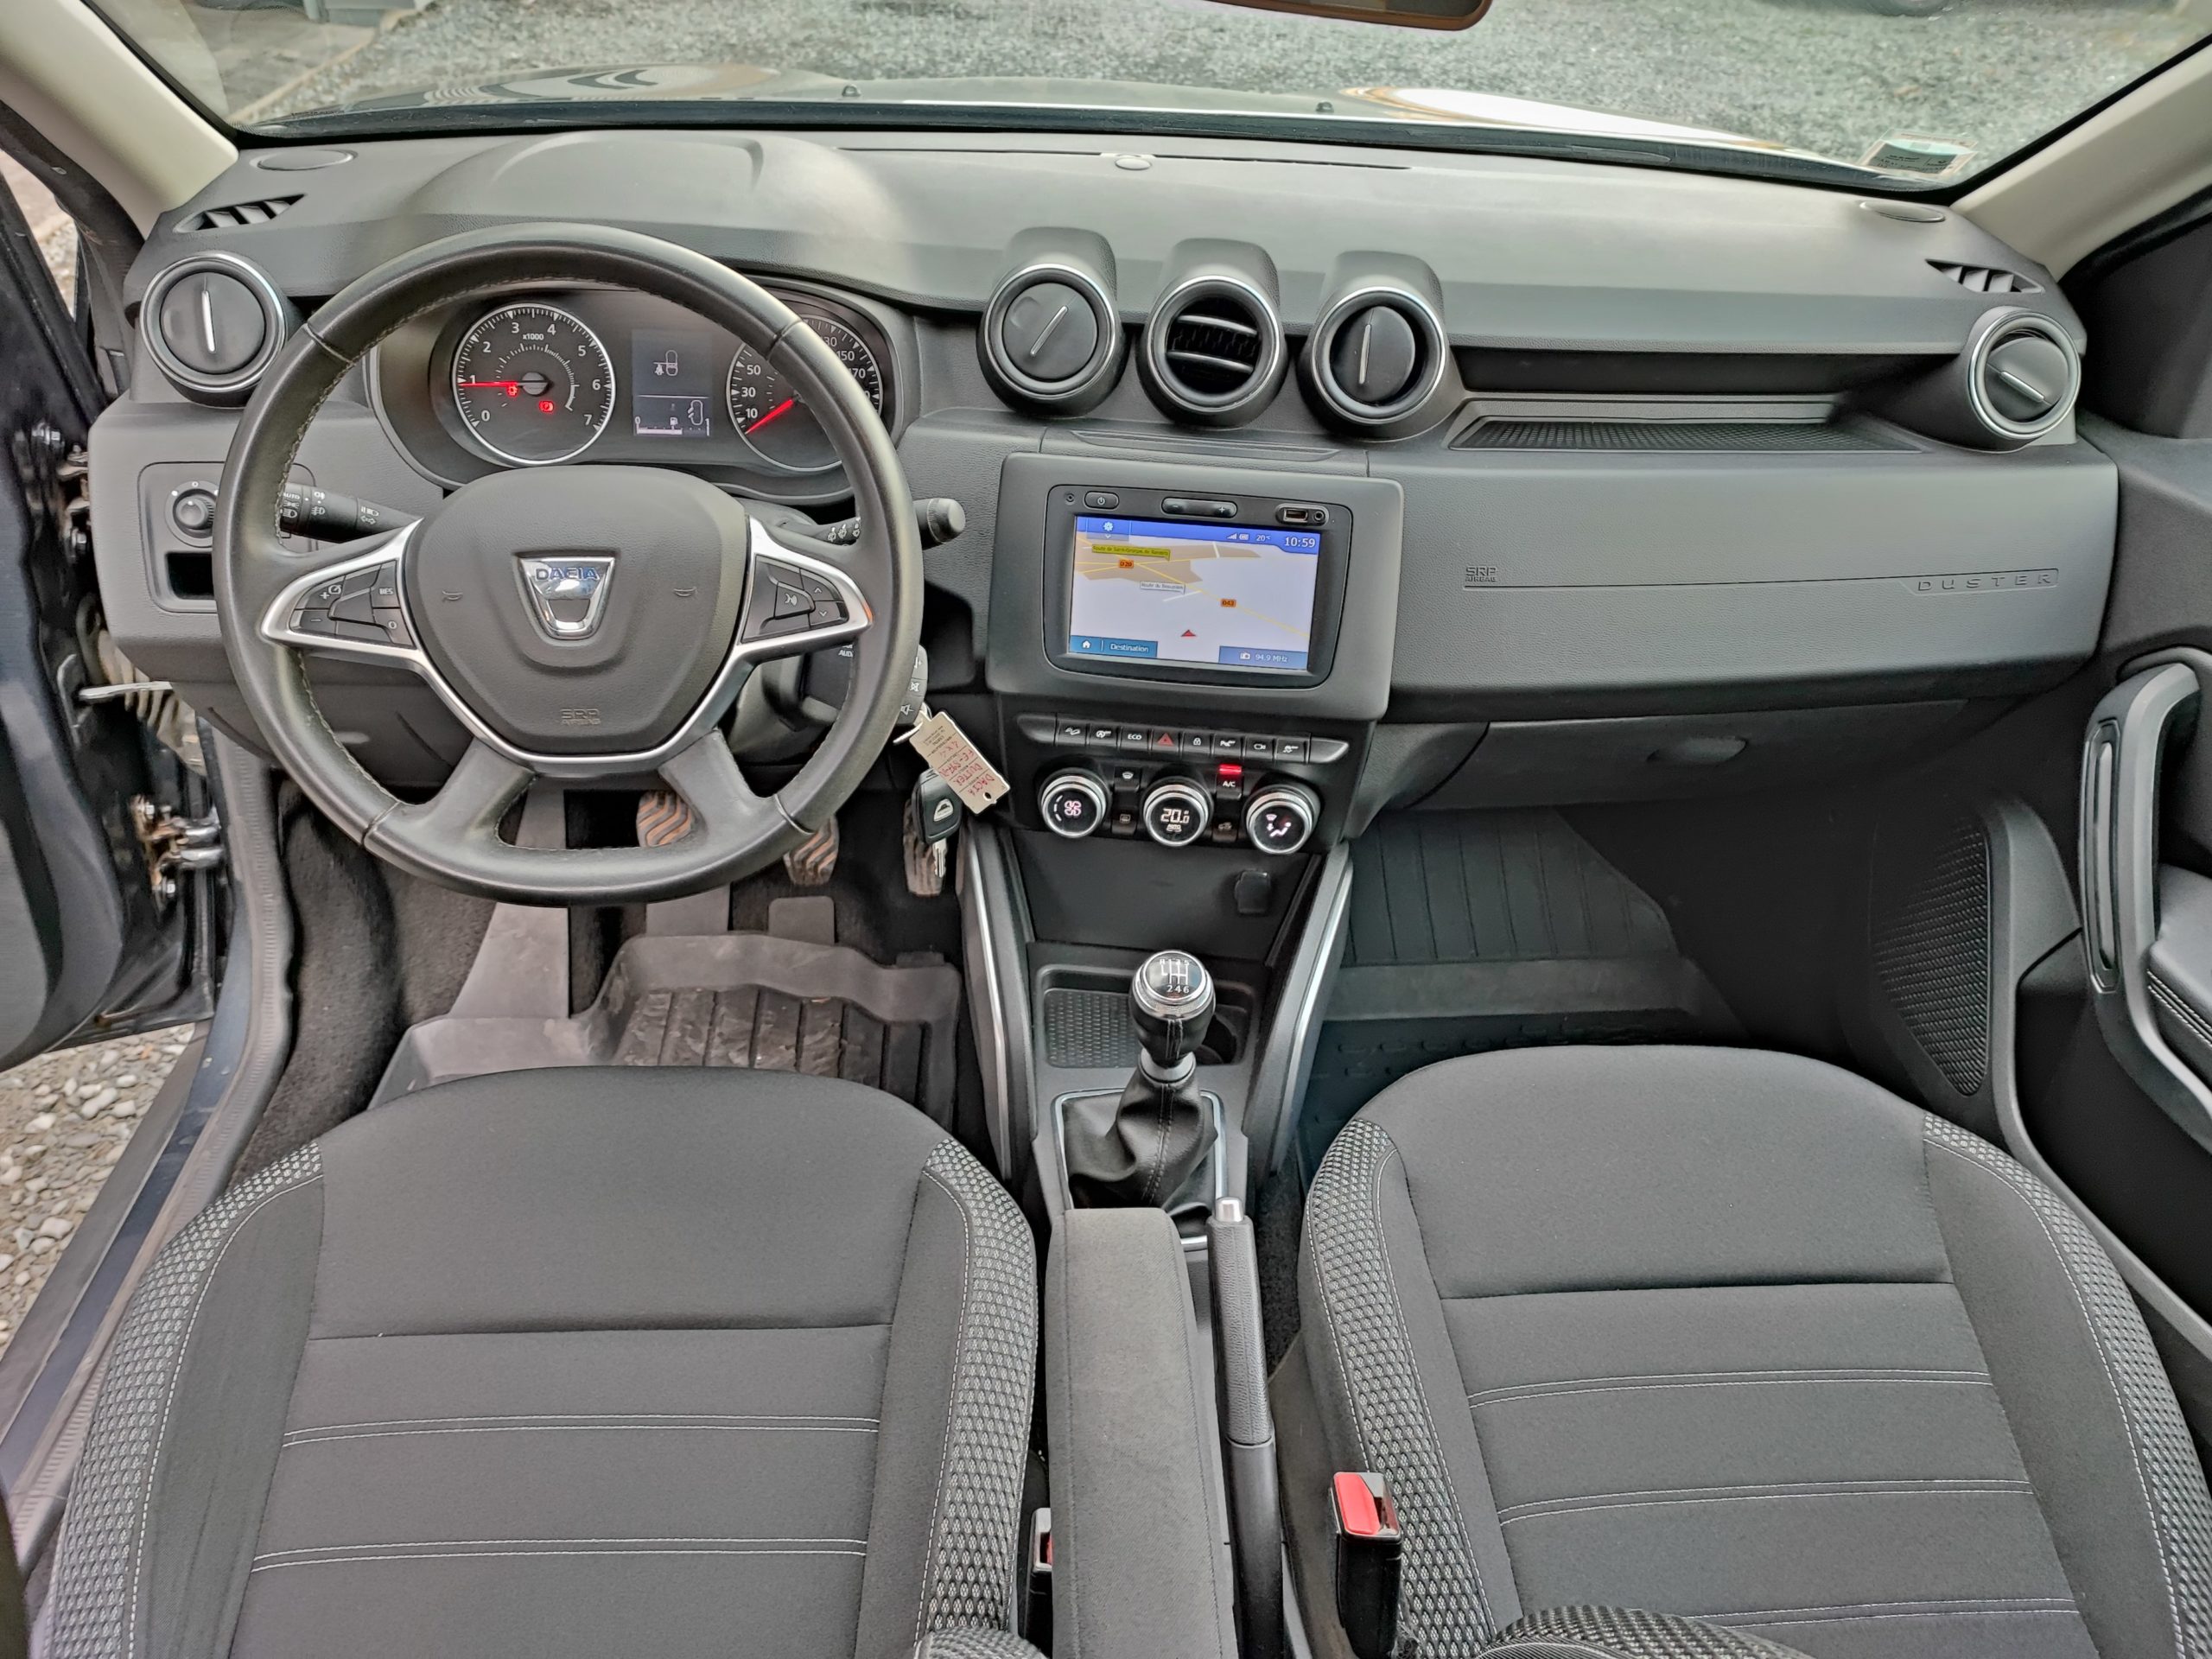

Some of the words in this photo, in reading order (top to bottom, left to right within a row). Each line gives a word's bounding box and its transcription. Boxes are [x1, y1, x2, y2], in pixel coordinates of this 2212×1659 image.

[511, 321, 519, 334] 3
[547, 323, 556, 335] 4
[823, 336, 837, 346] 30
[482, 341, 492, 353] 2
[578, 345, 587, 357] 5
[747, 365, 761, 375] 50
[850, 367, 866, 378] 70
[469, 374, 476, 385] 1
[592, 378, 601, 391] 6
[741, 386, 756, 397] 30
[480, 410, 491, 422] 0
[745, 408, 759, 419] 10
[583, 414, 593, 426] 7
[1285, 537, 1316, 548] 10:59
[535, 567, 601, 581] DACIA
[1465, 566, 1497, 576] SRP
[1917, 573, 2052, 592] DUSTER
[1110, 643, 1149, 652] Destination
[1255, 653, 1271, 662] 94.9
[1174, 985, 1182, 994] 4
